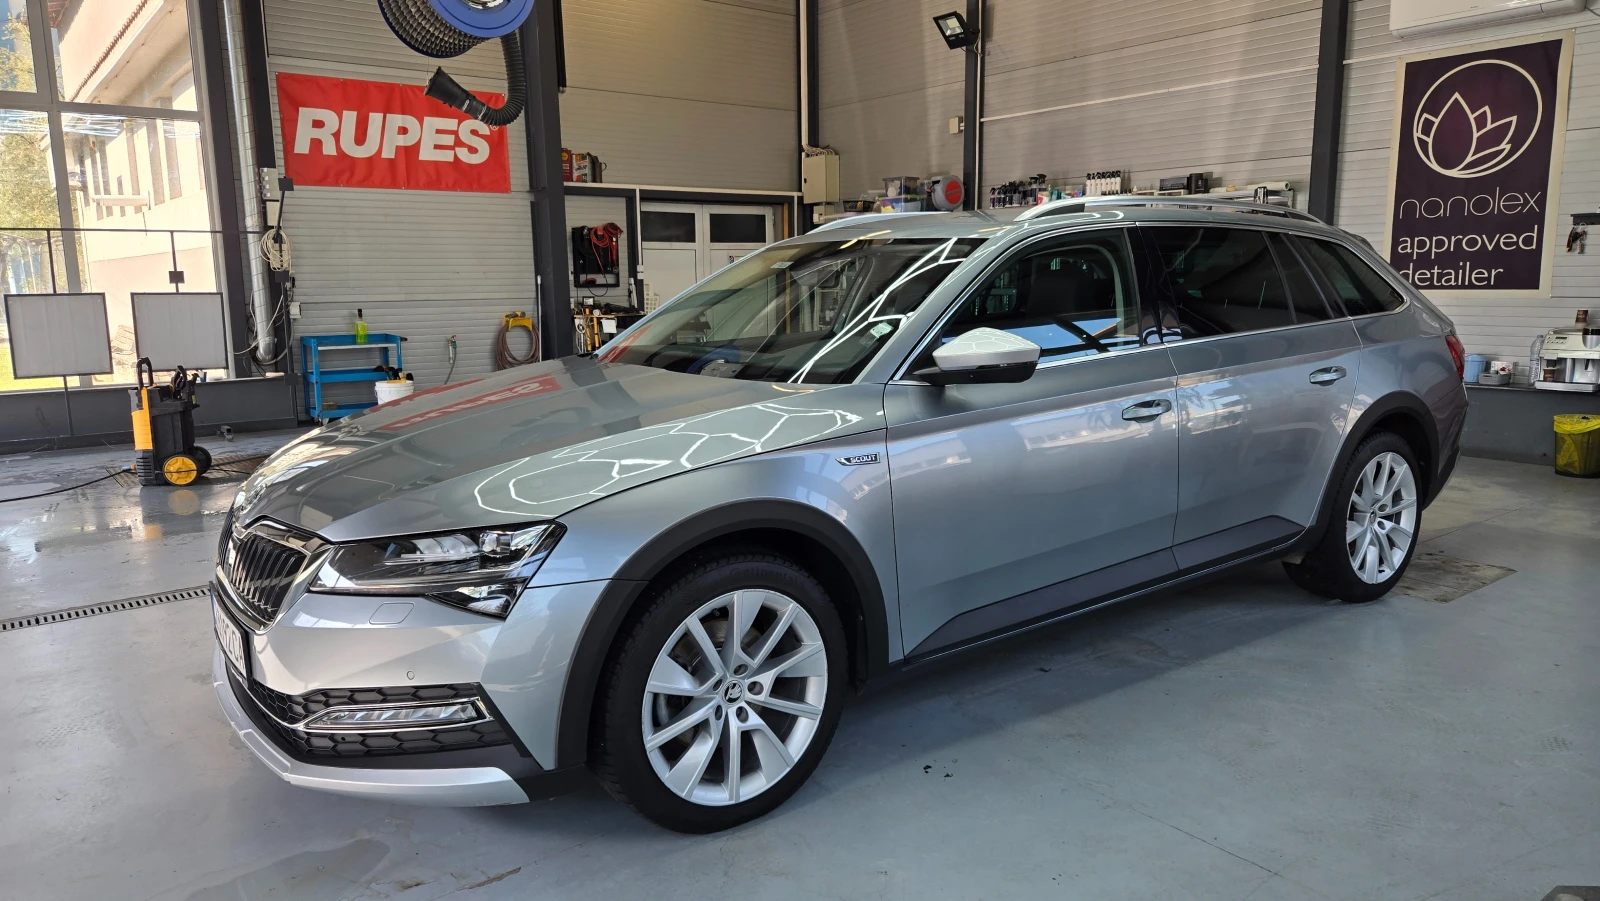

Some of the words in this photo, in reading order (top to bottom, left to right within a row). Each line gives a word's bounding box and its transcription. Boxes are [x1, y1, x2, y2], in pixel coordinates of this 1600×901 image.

[293, 106, 491, 165] RUPES
[1399, 186, 1542, 219] nanolex
[1397, 224, 1538, 260] approved
[850, 454, 876, 463] SCOUT
